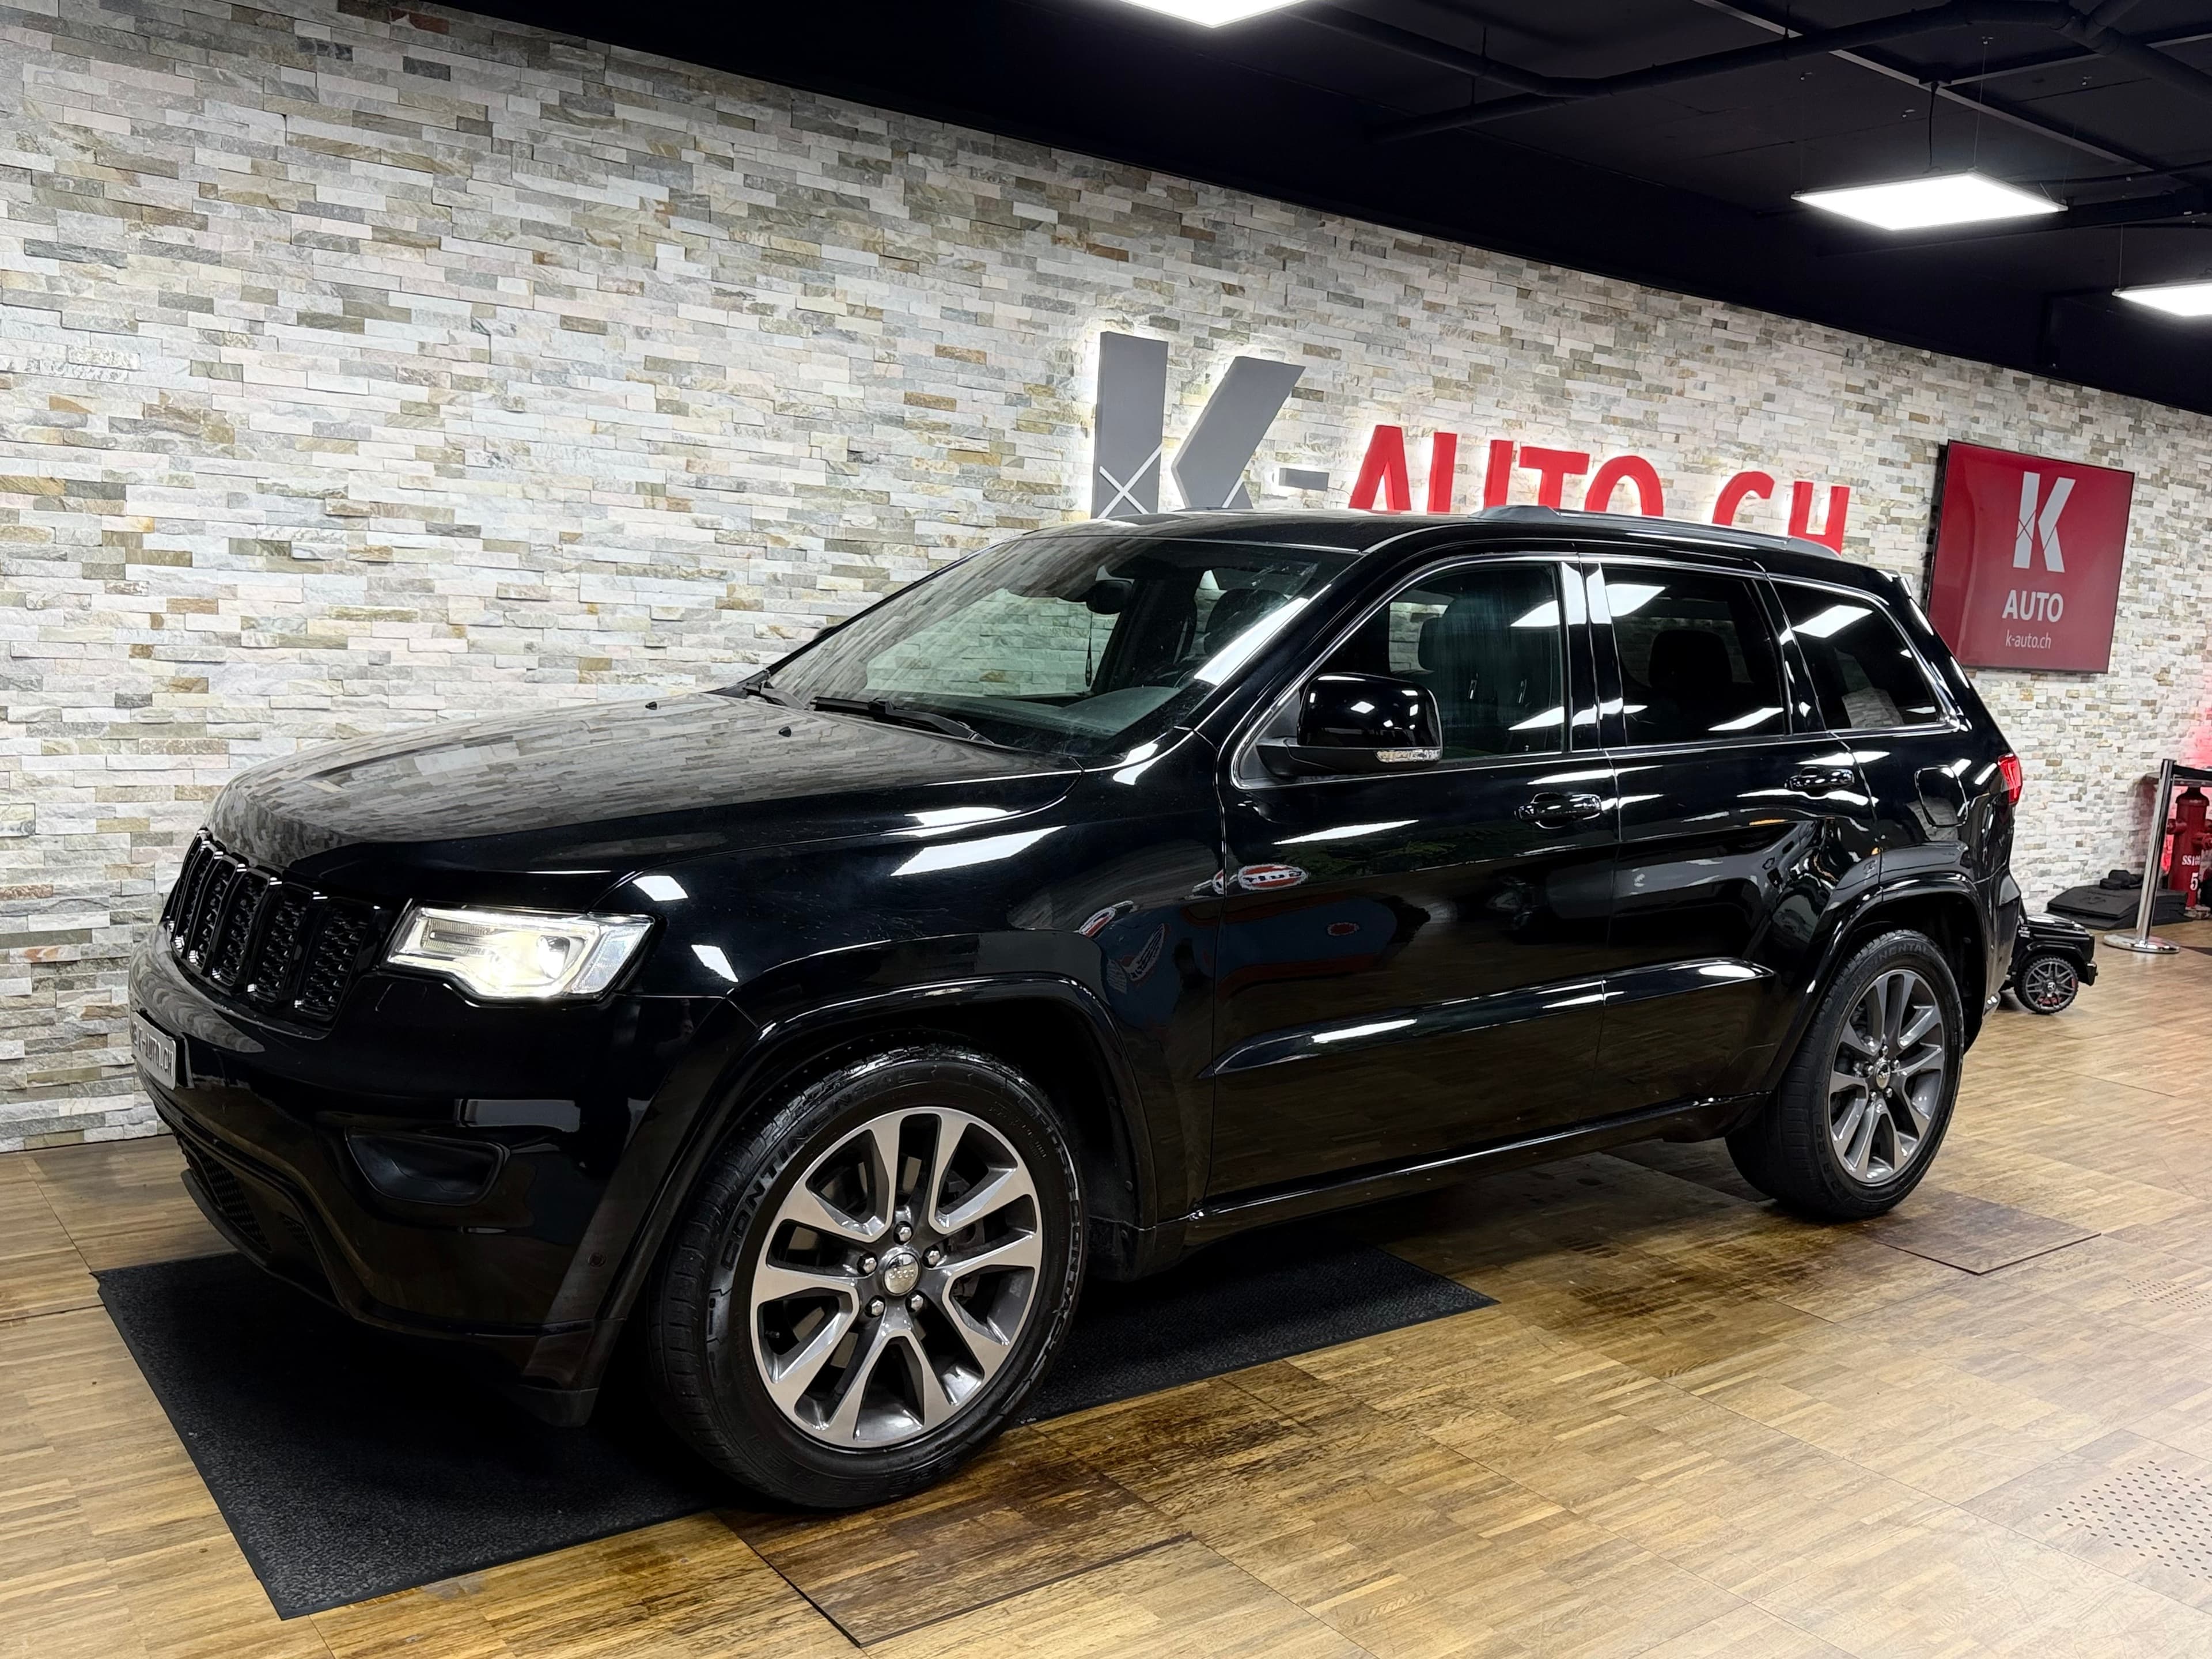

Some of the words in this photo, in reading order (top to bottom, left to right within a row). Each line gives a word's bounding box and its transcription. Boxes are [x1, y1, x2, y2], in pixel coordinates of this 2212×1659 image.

[2012, 471, 2076, 573] K
[2002, 589, 2063, 623] AUTO
[2005, 629, 2051, 649] k-auto.ch
[2190, 872, 2199, 891] 5
